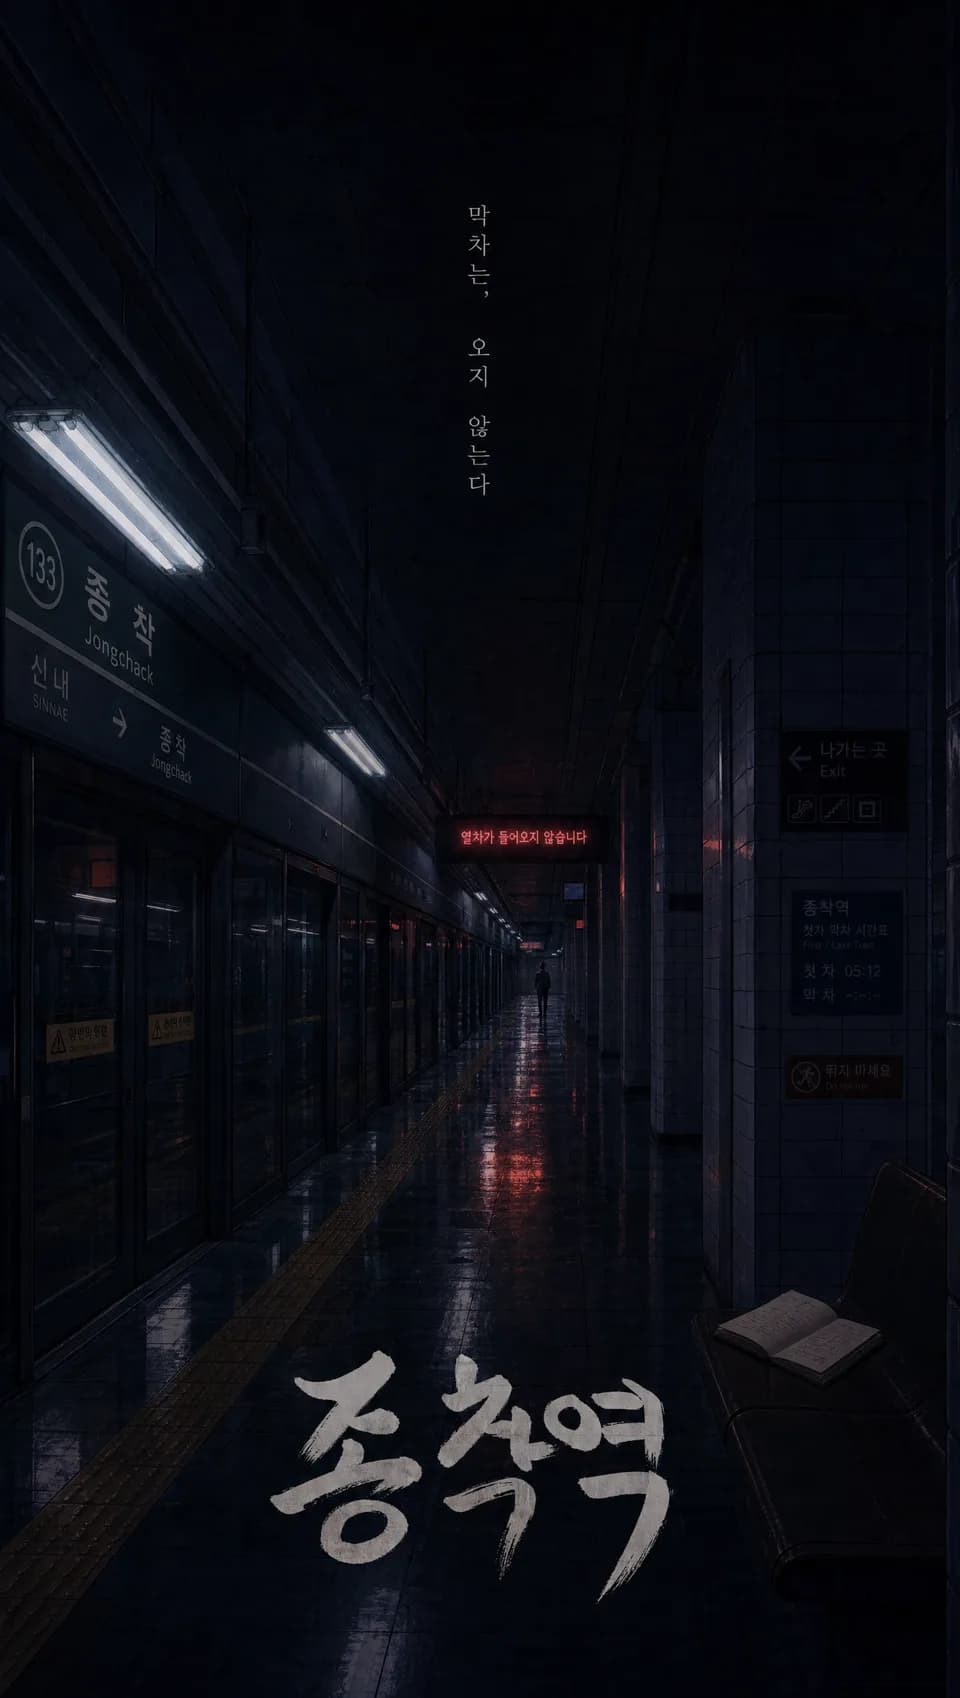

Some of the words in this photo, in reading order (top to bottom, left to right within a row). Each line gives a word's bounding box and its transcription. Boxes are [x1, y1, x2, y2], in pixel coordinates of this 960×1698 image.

[26, 541, 56, 592] 133
[84, 624, 155, 687] Jongchack
[31, 649, 70, 702] 신내
[31, 693, 70, 723] SINNAE
[820, 740, 864, 759] 나가는
[151, 753, 193, 785] Jongchack
[820, 763, 847, 778] Exit
[460, 829, 495, 846] 열차가
[498, 829, 539, 846] 들어오지
[543, 829, 588, 846] 않습니다
[801, 899, 849, 918] 종착역
[844, 963, 881, 978] 05:12
